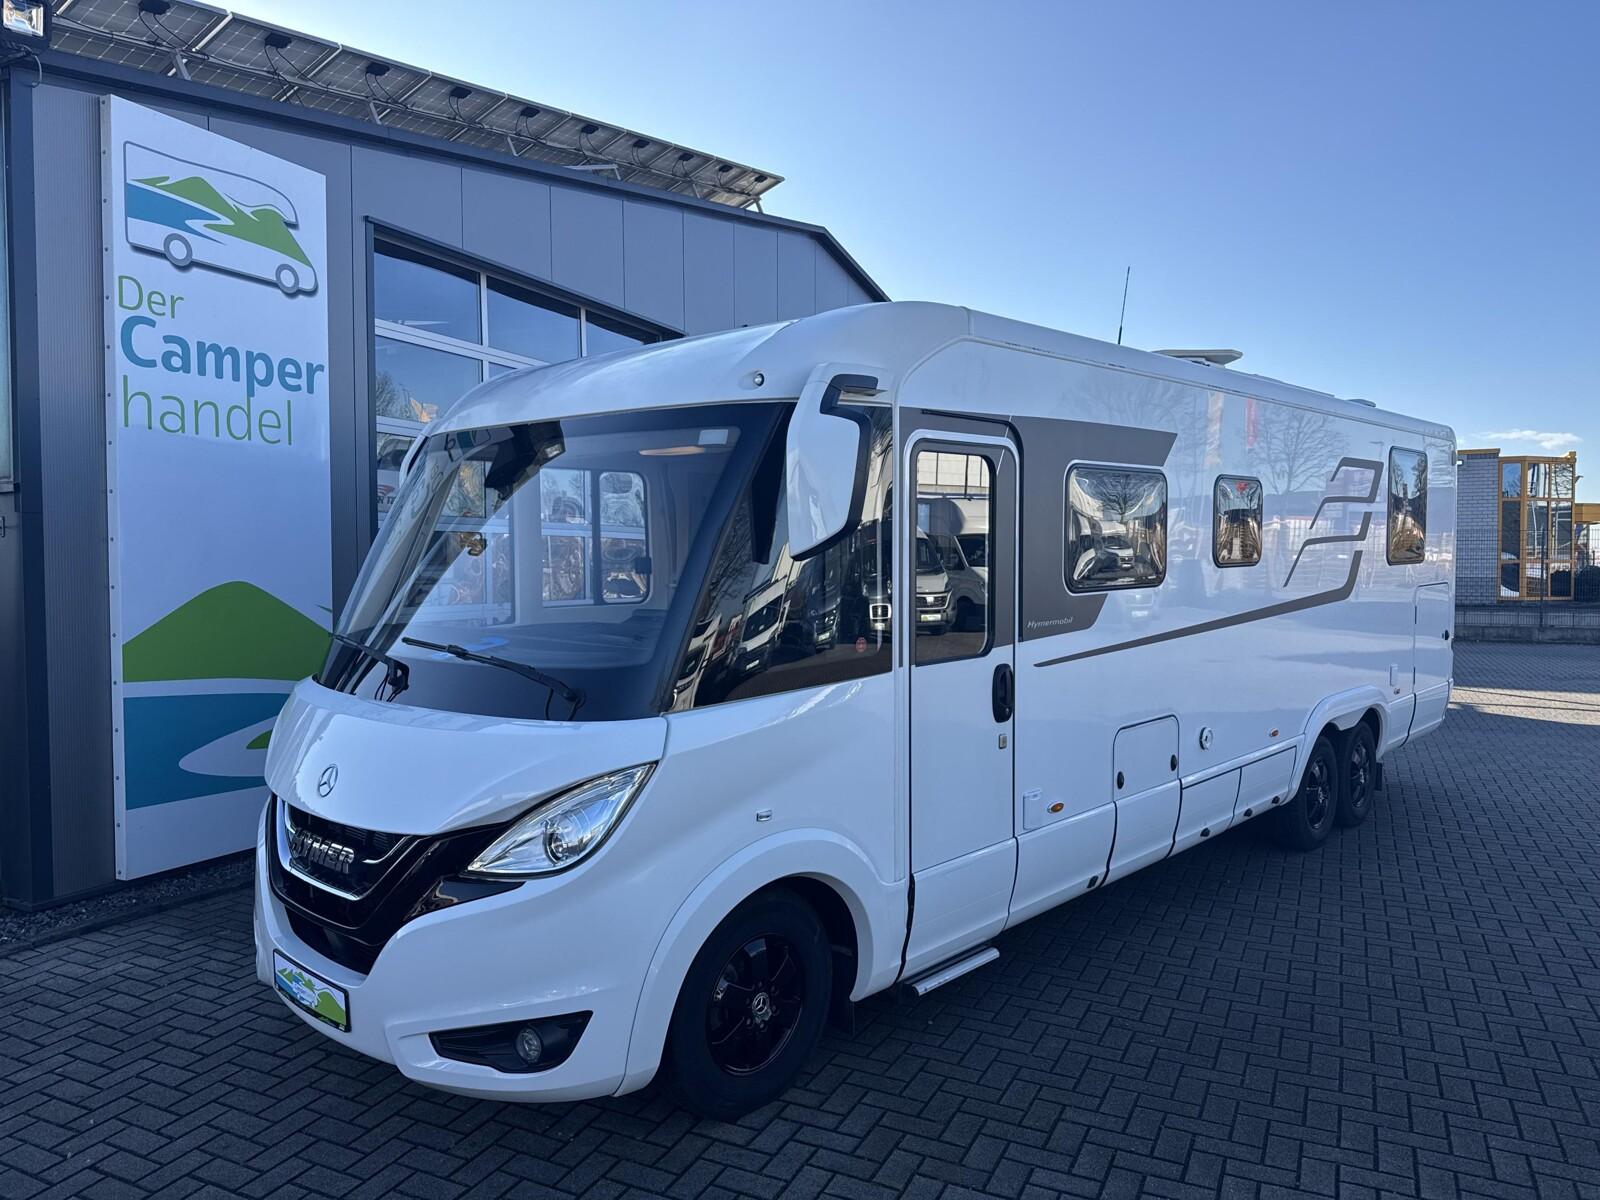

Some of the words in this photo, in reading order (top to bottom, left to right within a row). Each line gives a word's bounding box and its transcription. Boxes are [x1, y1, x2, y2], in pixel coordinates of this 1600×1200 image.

[118, 275, 184, 319] Der
[120, 315, 325, 398] Camper
[122, 374, 292, 446] handel
[1027, 616, 1073, 629] Hymermobil
[290, 829, 355, 874] HYMER
